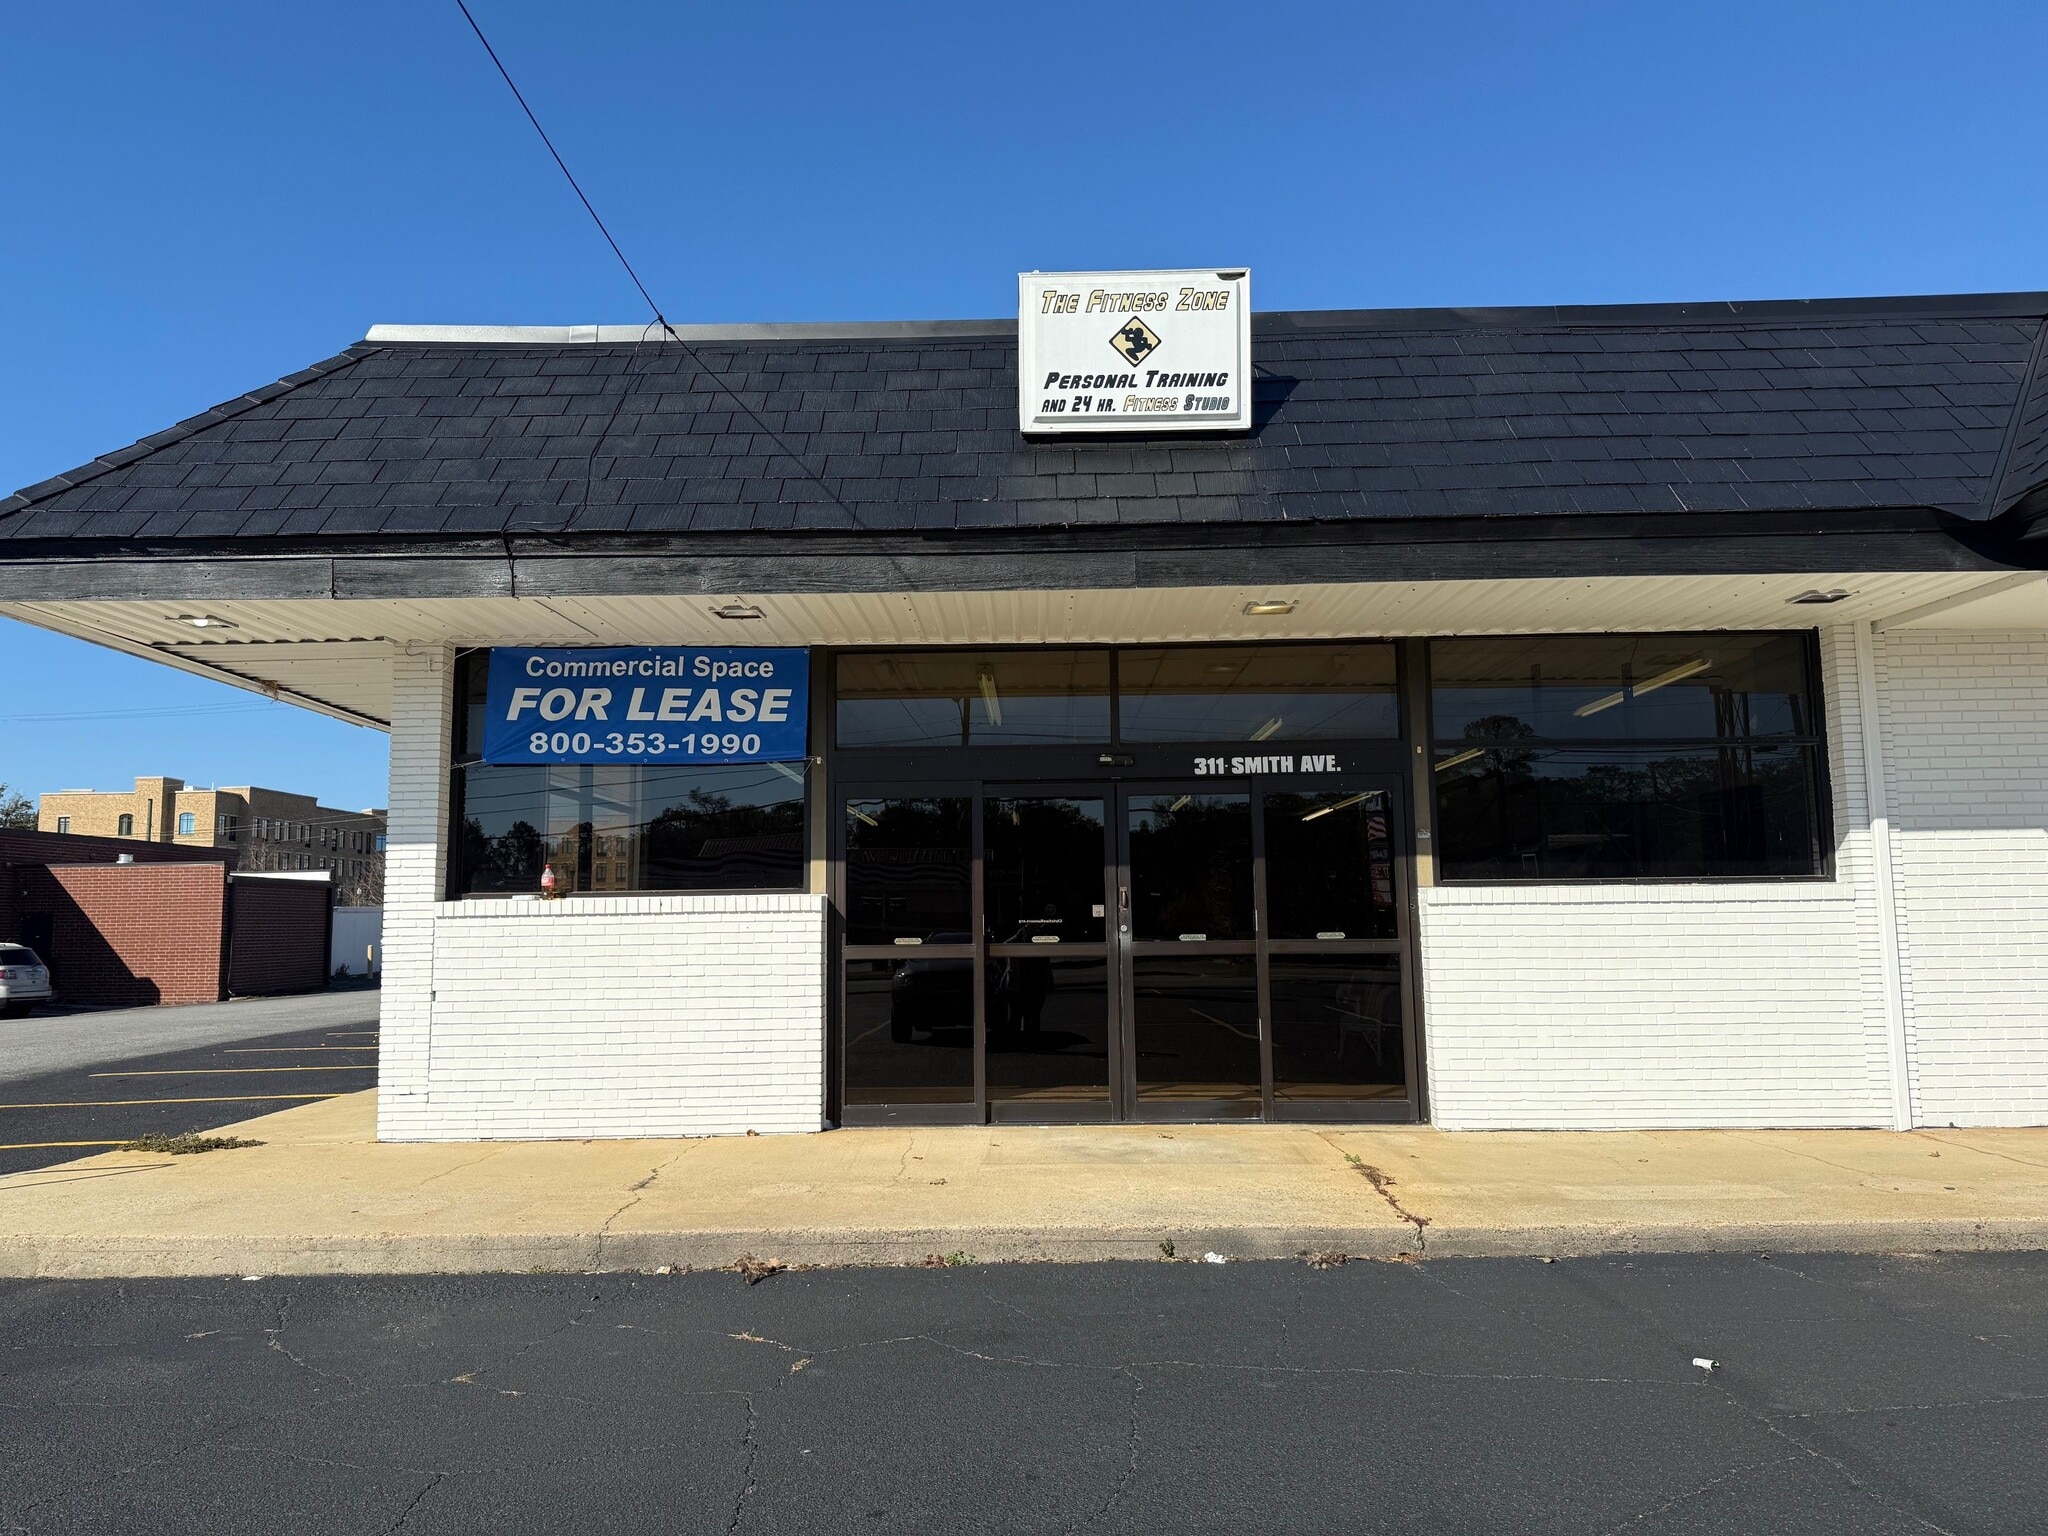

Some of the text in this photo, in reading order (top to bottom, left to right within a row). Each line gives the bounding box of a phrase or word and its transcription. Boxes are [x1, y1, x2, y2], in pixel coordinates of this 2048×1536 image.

[1041, 287, 1230, 314] THE FITNESS ZONE
[1043, 370, 1229, 390] PERSONAL TRAINING
[1041, 394, 1230, 413] AND 24 HR. FITNESS STUDIO
[525, 655, 774, 682] Commercial Space
[506, 687, 793, 722] FOR LEASE
[529, 732, 761, 755] 800-353-1990
[1194, 755, 1342, 775] 311 SMITH AVE.
